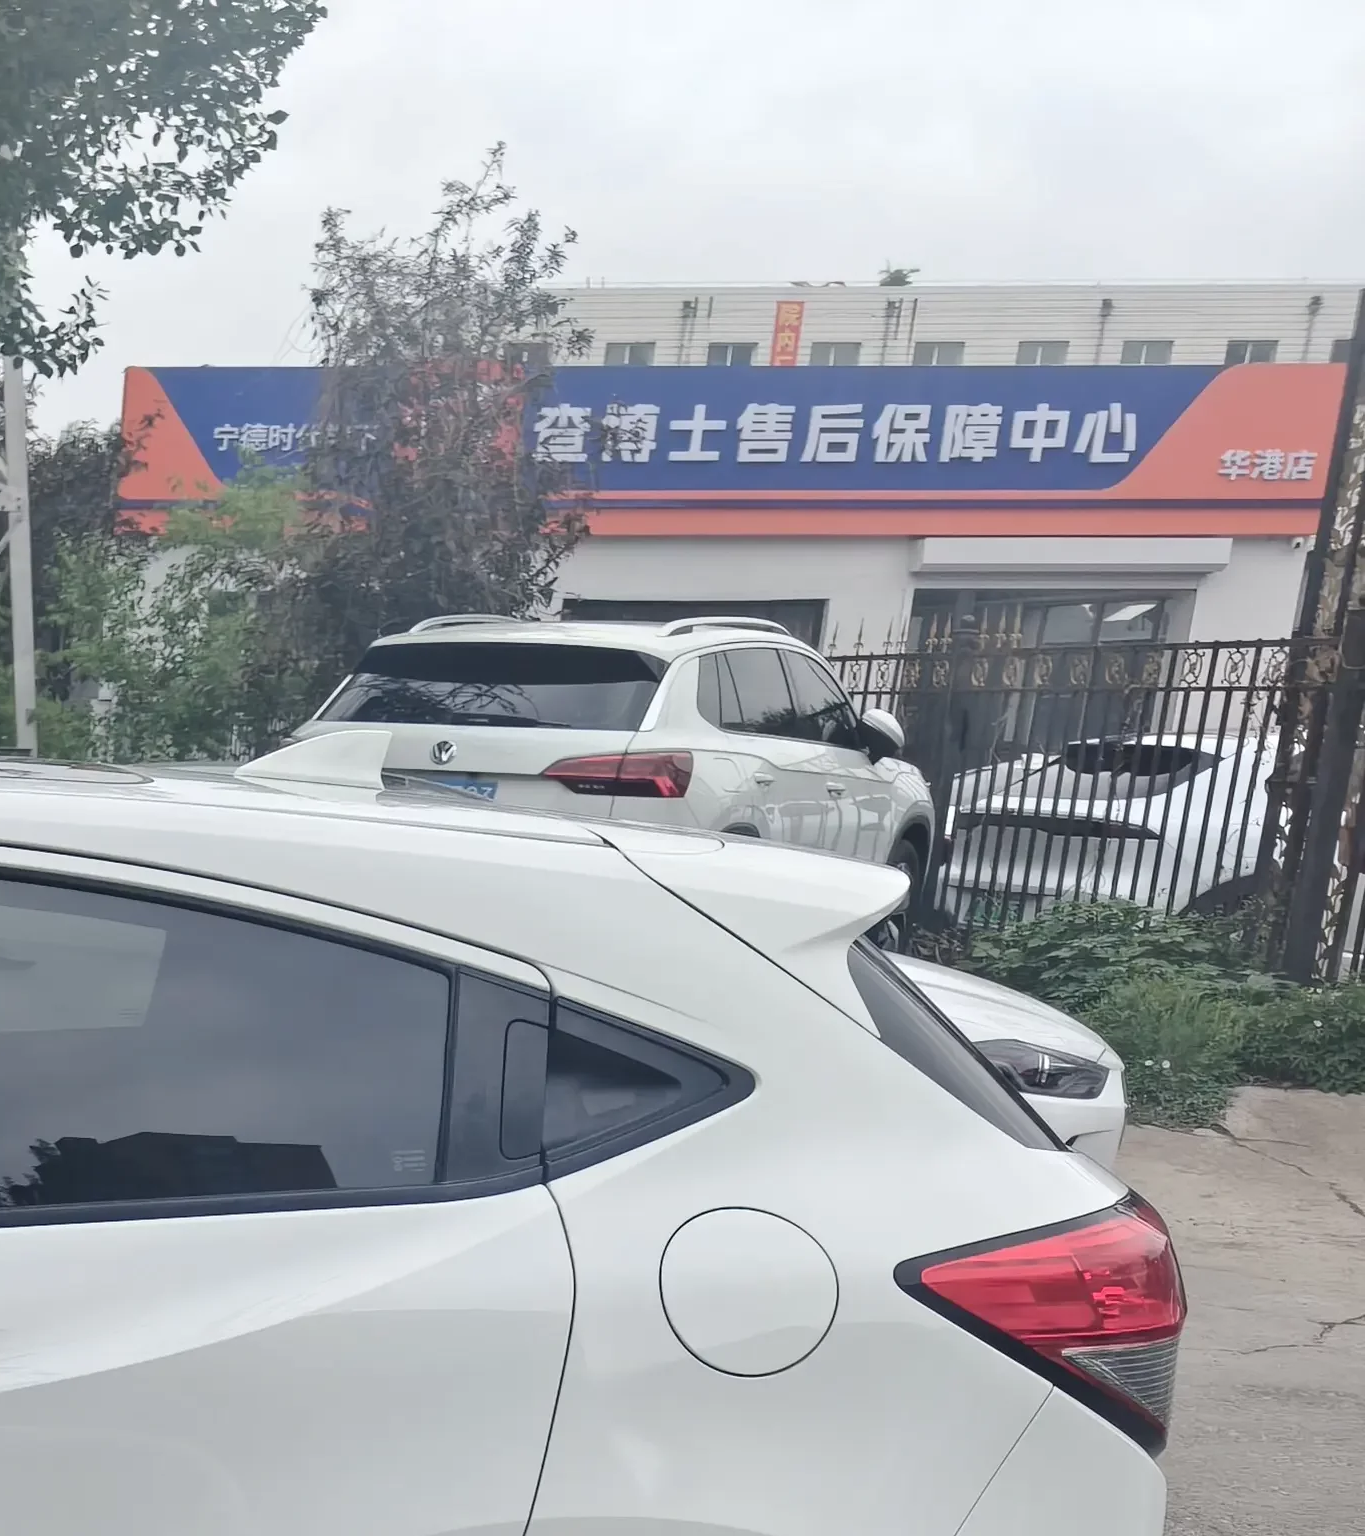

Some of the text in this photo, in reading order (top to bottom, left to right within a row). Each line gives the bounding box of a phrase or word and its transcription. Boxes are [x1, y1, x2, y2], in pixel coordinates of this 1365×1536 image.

[532, 403, 1136, 464] 查博士售后保障中心
[1217, 448, 1318, 480] 华港店
